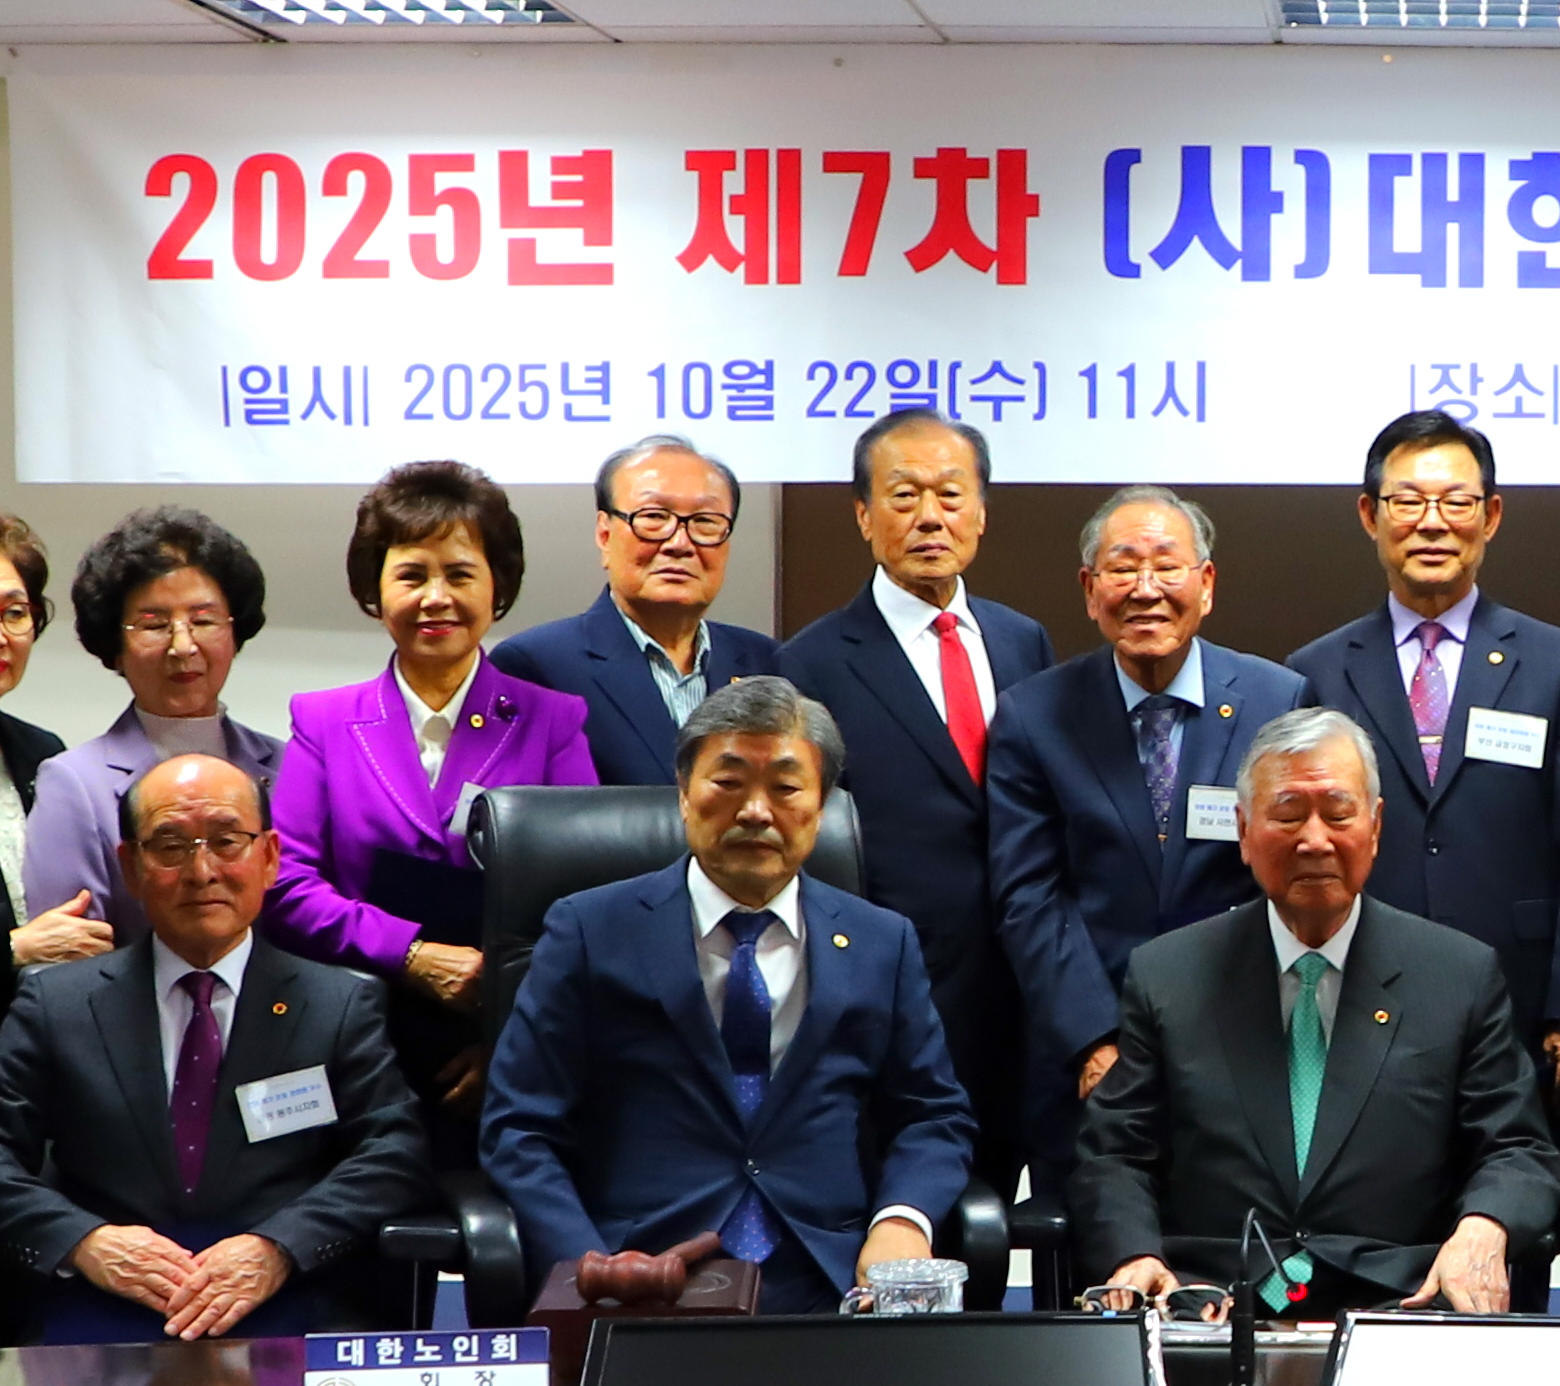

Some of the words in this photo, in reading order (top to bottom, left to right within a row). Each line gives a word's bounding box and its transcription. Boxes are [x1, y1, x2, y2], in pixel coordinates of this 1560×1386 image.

[144, 147, 614, 287] 2025년
[676, 146, 1042, 286] 제7차
[403, 360, 612, 423] 2025년
[646, 358, 776, 422] 10월
[1078, 359, 1207, 424] 11시
